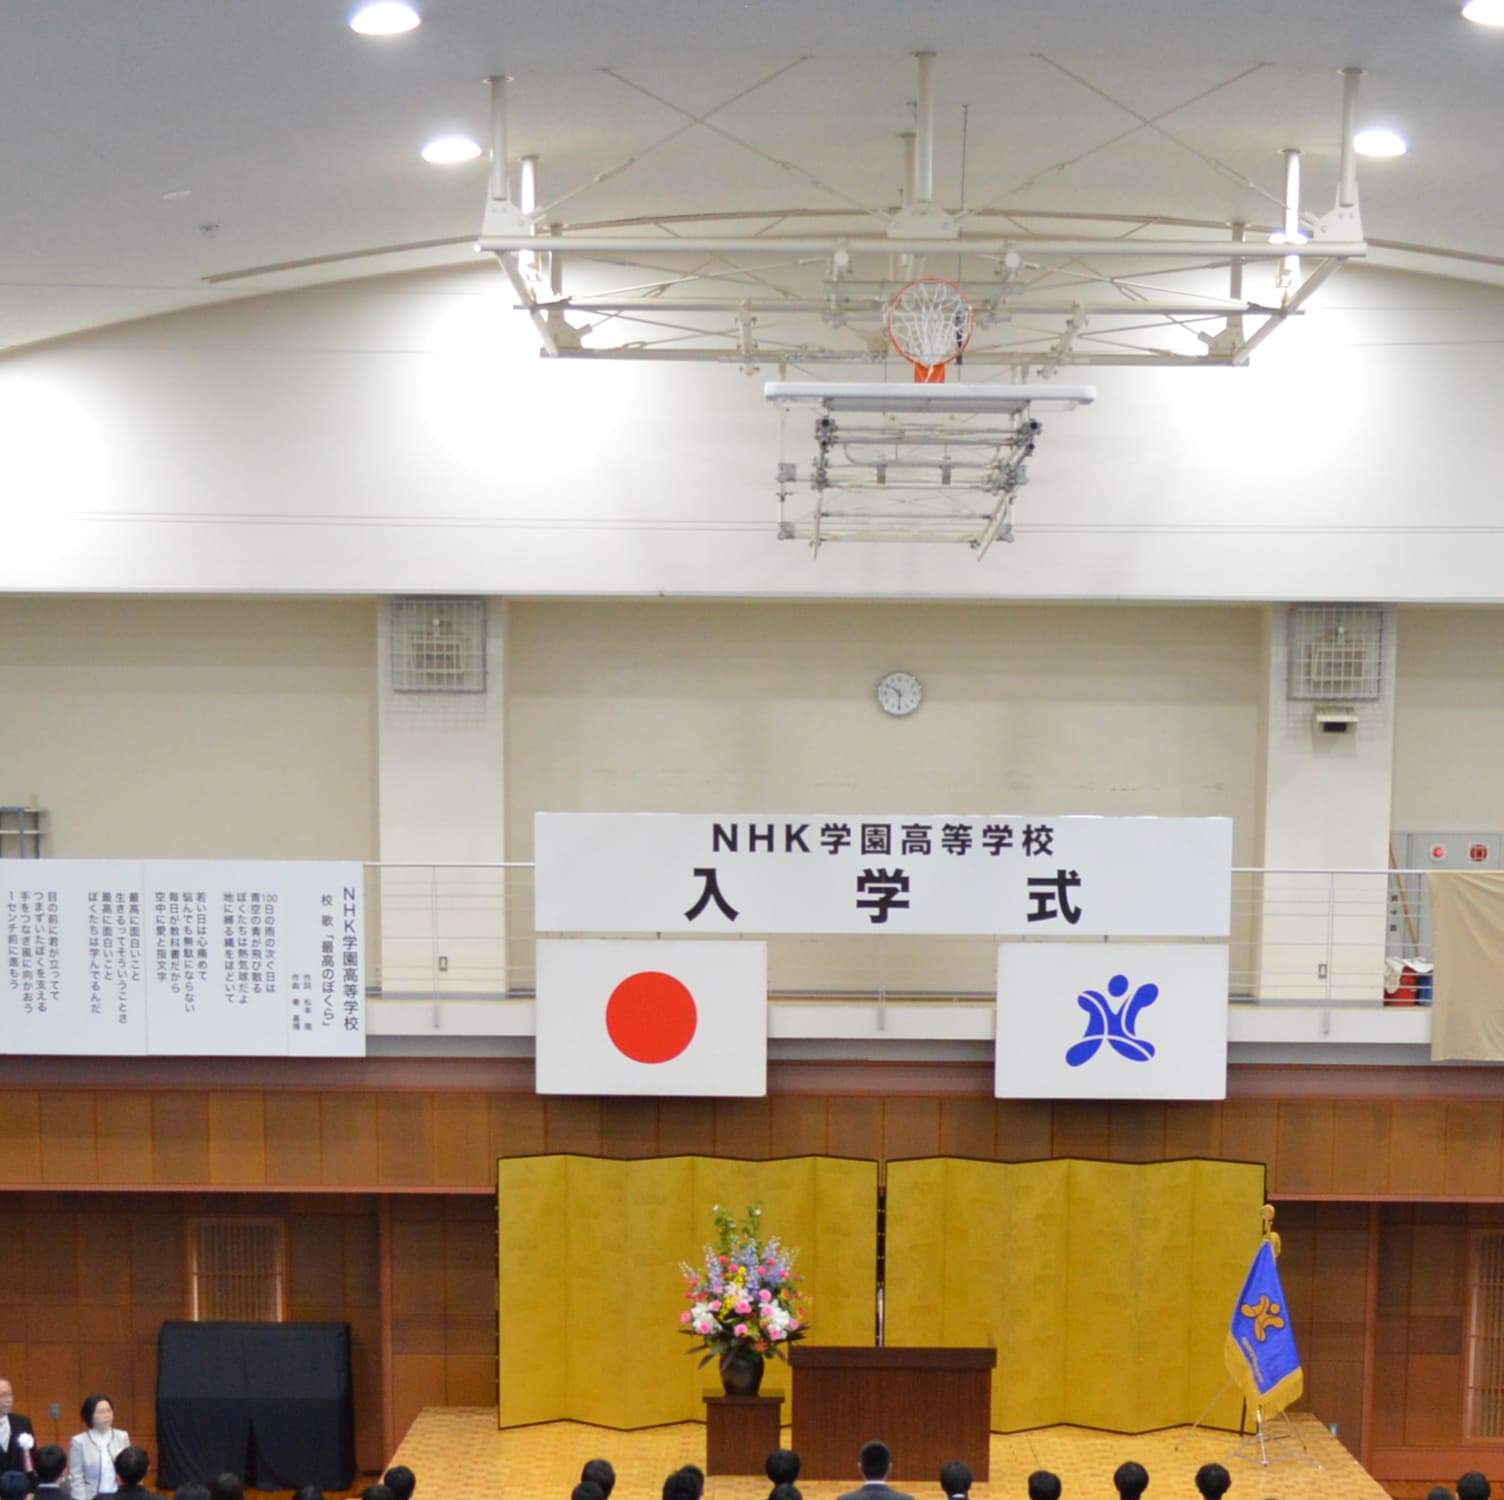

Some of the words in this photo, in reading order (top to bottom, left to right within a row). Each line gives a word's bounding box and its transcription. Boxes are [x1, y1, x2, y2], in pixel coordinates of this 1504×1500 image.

[711, 822, 1055, 857] NHK学園高等学校
[683, 866, 1082, 925] 入学式
[342, 886, 360, 1032] NHK学園高等学校
